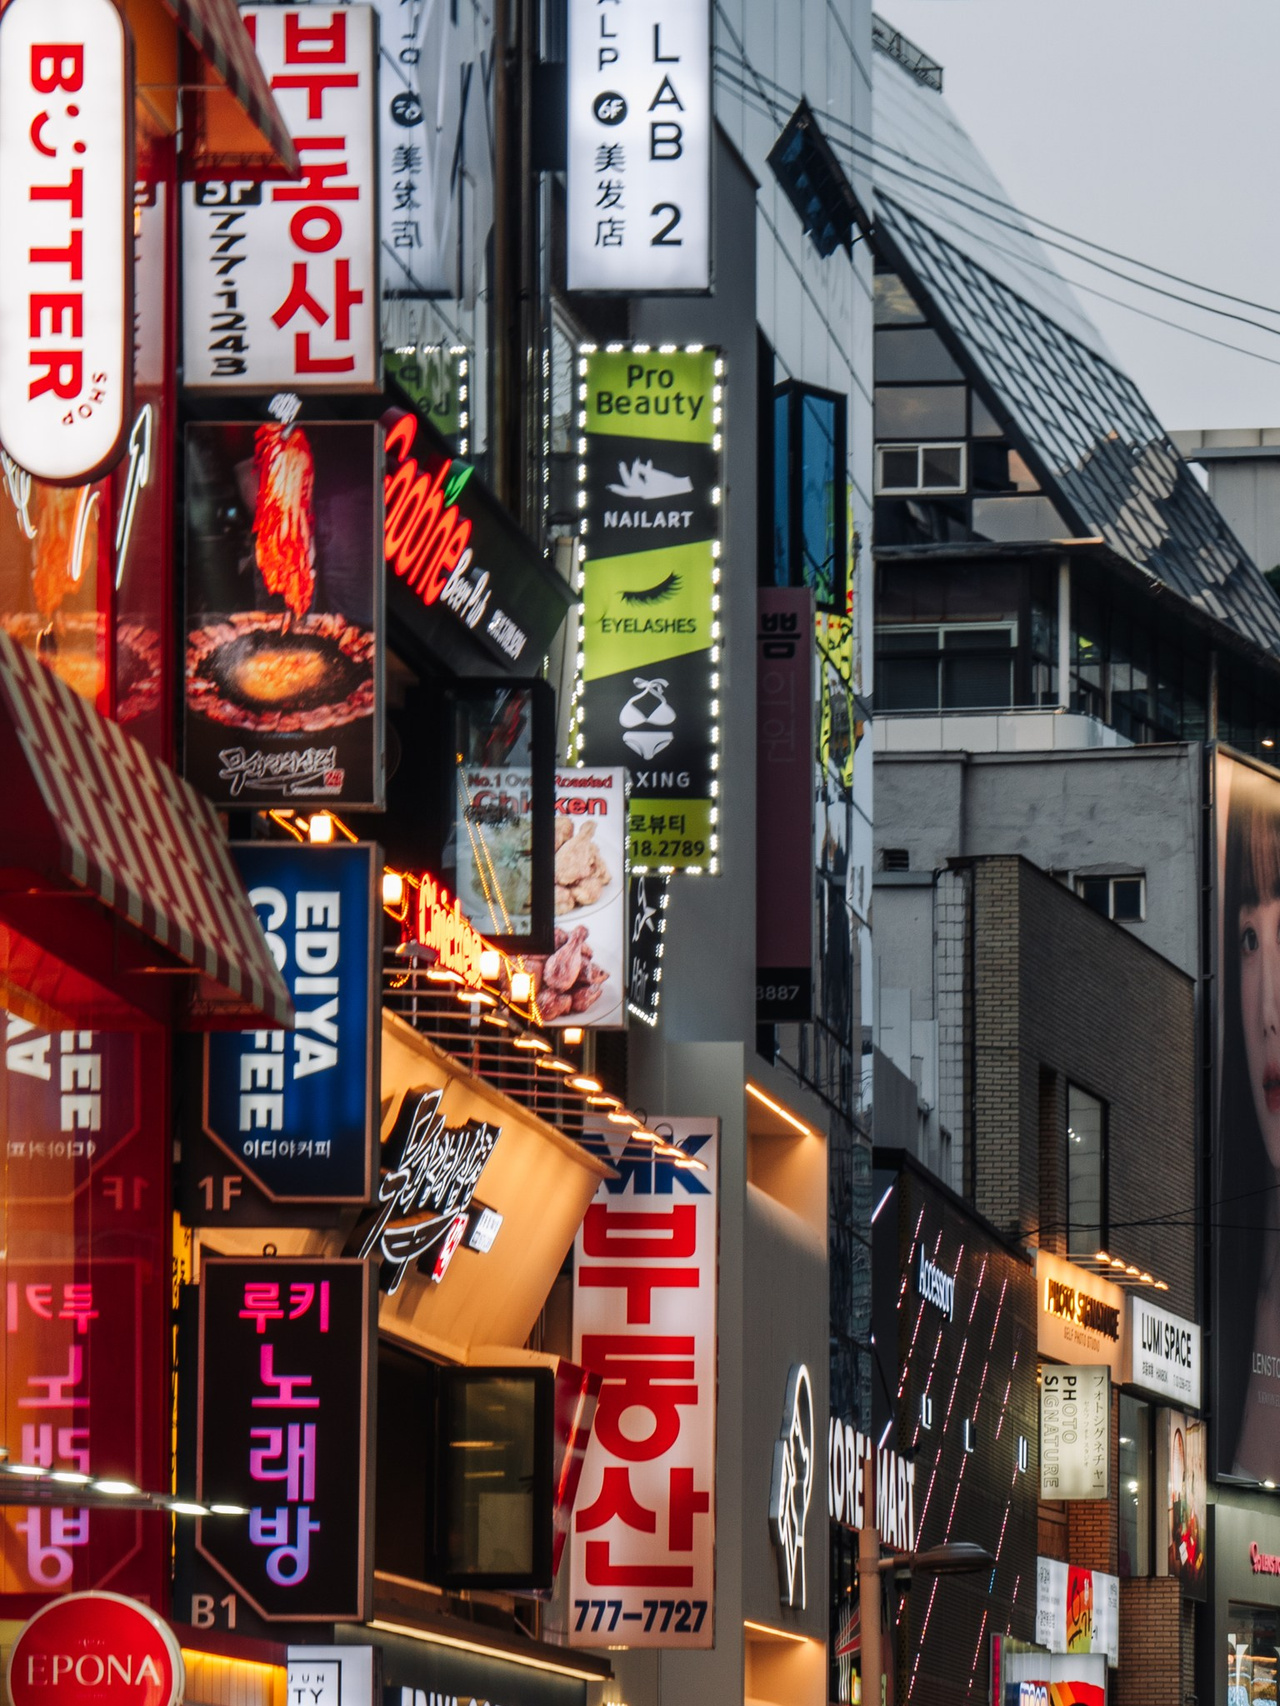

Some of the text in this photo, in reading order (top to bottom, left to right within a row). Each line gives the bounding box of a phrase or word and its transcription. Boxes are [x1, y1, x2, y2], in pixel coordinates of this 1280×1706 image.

[648, 23, 685, 246] LAB 2
[271, 12, 363, 375] 부동산
[594, 142, 627, 248] 美发店
[62, 372, 107, 426] SHOP
[627, 364, 674, 389] Pro
[596, 391, 704, 421] Beauty
[604, 511, 694, 528] NAILART
[601, 617, 697, 635] EYELASHES
[468, 774, 500, 788] No.1
[473, 790, 608, 816] Chiken
[629, 771, 691, 788] XING
[239, 886, 288, 1131] CFEE
[294, 891, 340, 1080] EDIYA
[243, 1139, 331, 1160] 이디야커피
[199, 1176, 242, 1211] 1F
[239, 1281, 330, 1334] 루키
[918, 1243, 955, 1323] Accessory
[1141, 1312, 1192, 1369] LUMI SPACE
[575, 1203, 710, 1588] 부동산
[1062, 1375, 1078, 1445] PHOTO
[1043, 1375, 1060, 1489] SIGNATURE
[249, 1343, 321, 1587] 노래방
[876, 1447, 916, 1552] MART
[191, 1594, 238, 1630] B1
[574, 1601, 708, 1633] 777-7727
[28, 1653, 160, 1686] EPONA
